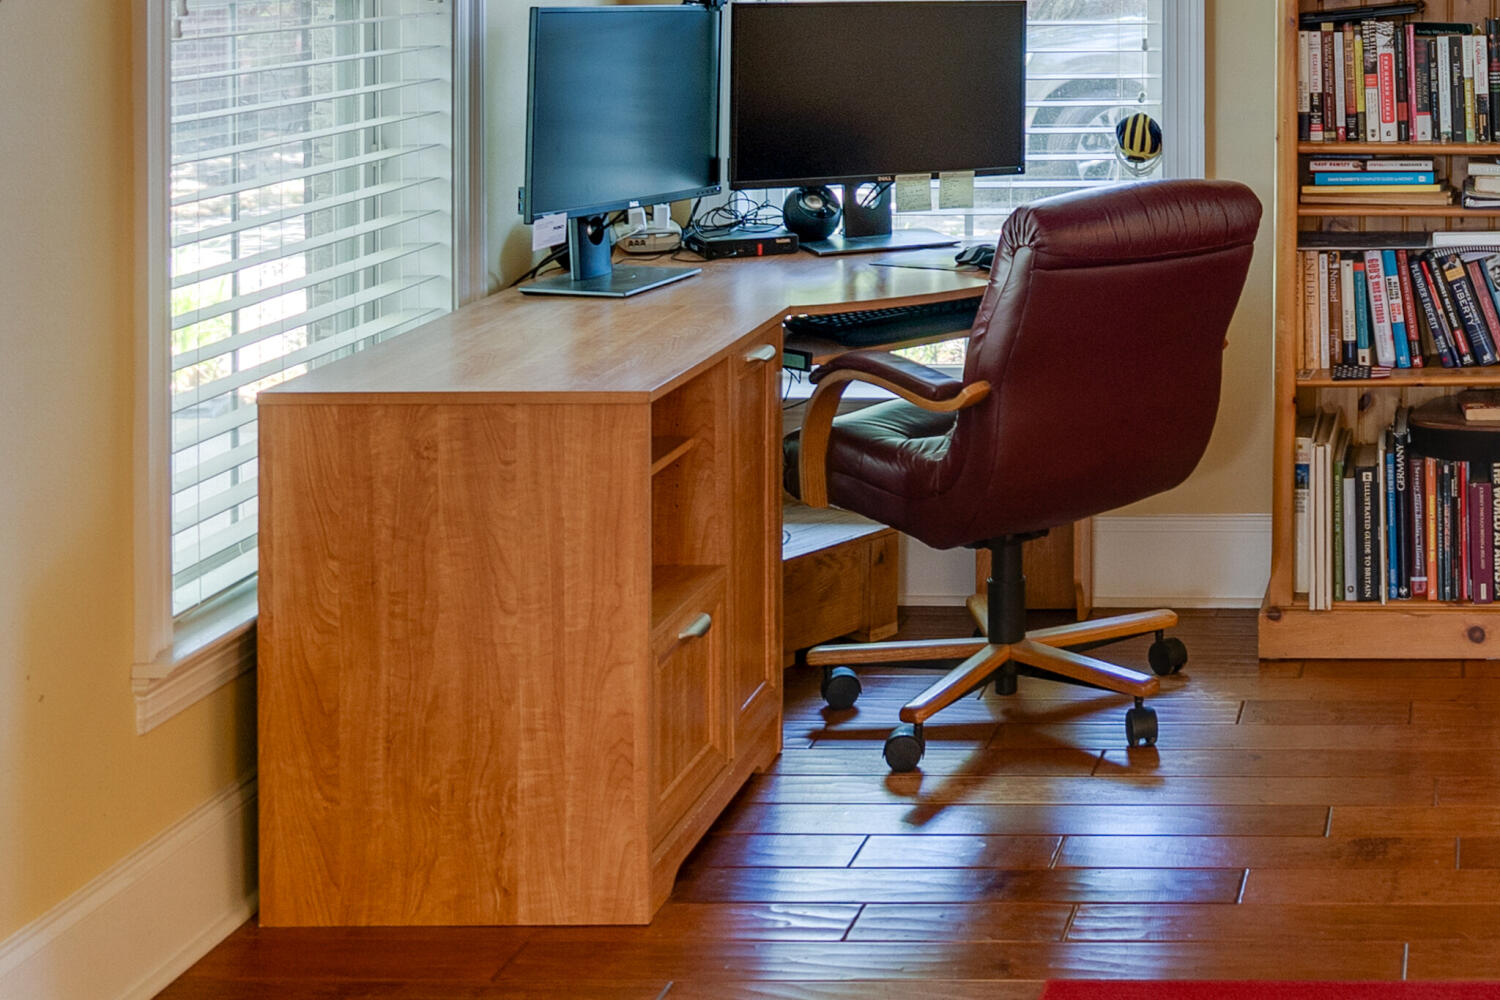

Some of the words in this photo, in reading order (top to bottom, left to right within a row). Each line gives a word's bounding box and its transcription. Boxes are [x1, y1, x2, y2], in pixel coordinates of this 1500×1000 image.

[1305, 256, 1316, 309] INFIDEL
[1367, 257, 1382, 280] GOD'S
[1330, 269, 1338, 303] Nomad
[1372, 280, 1382, 294] WAR
[1387, 277, 1396, 300] AMERICA
[1410, 263, 1427, 299] PLUNDER
[1424, 303, 1438, 330] DECEIT
[1375, 303, 1385, 324] TERROR
[1453, 283, 1474, 326] LIBERTY
[1396, 444, 1405, 491] GERMANY
[1363, 481, 1371, 529] ILLUSTRATED
[1363, 531, 1371, 554] GUIDE
[1364, 556, 1371, 566] TO
[1364, 567, 1372, 598] BRITAIN
